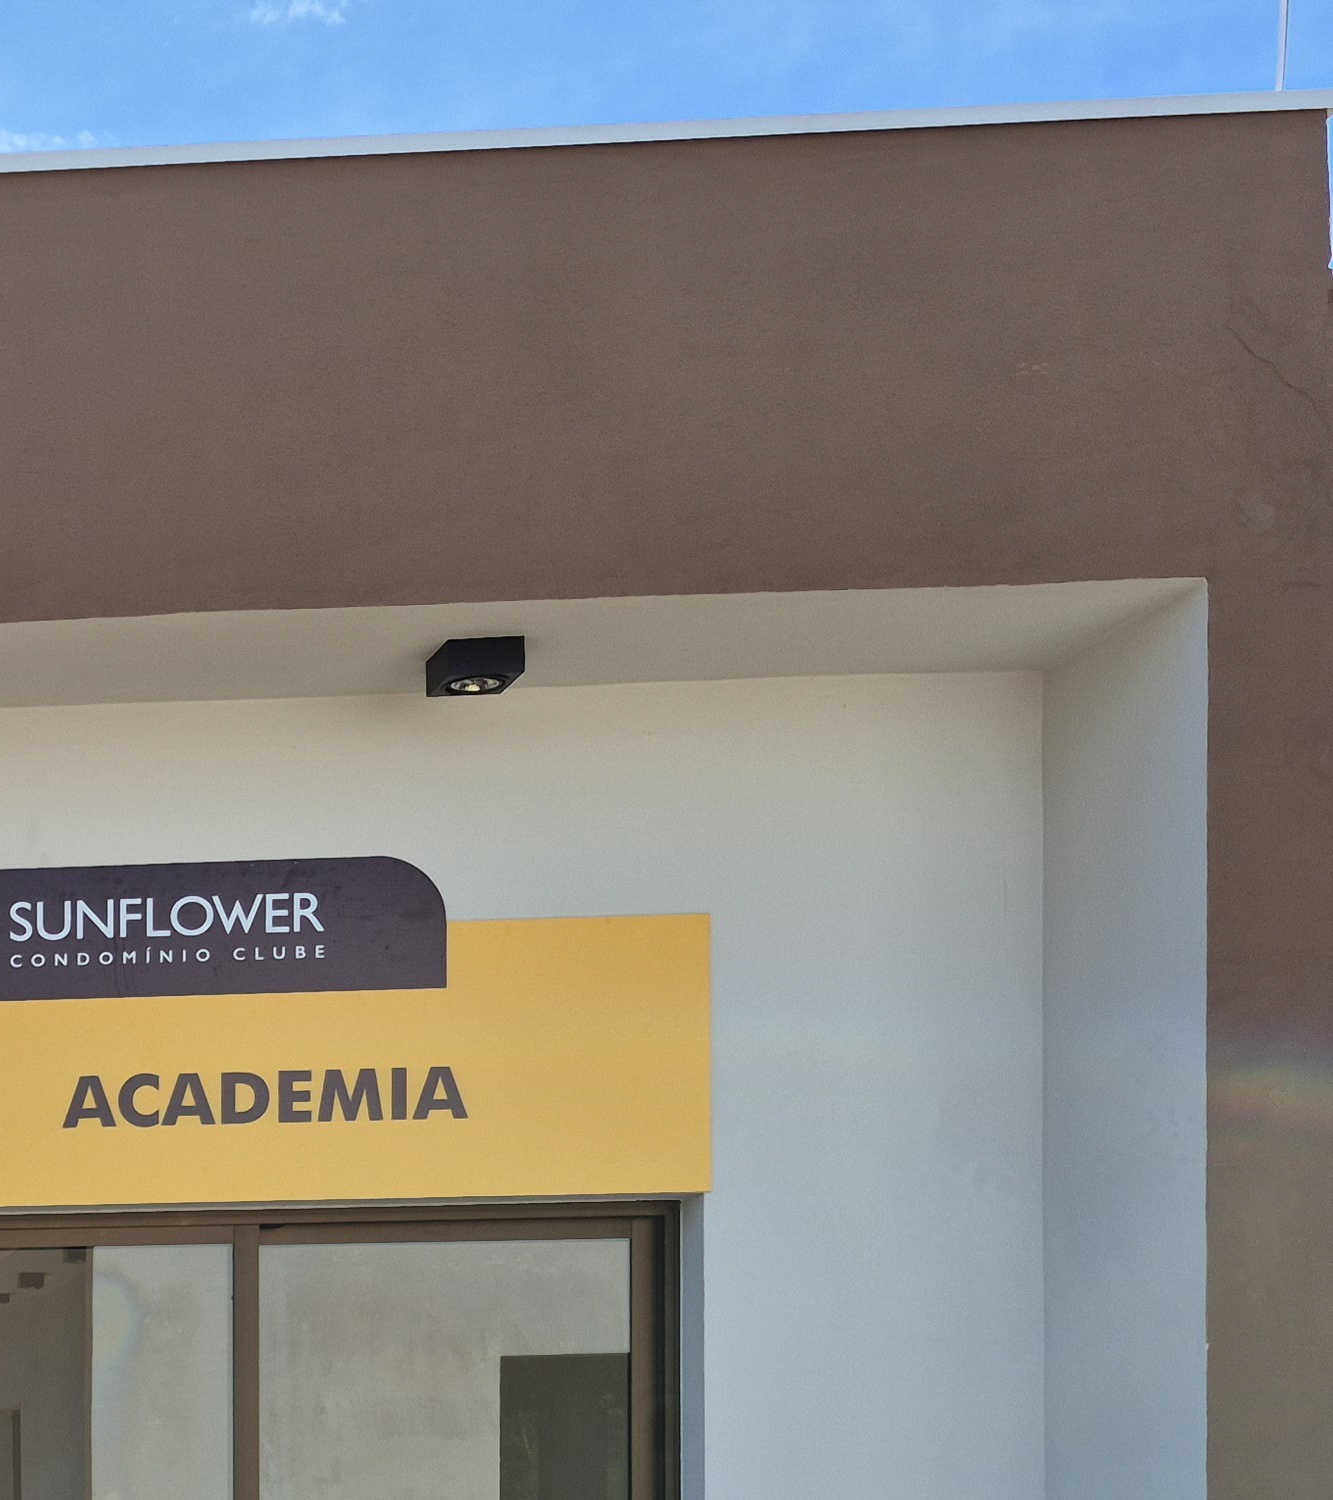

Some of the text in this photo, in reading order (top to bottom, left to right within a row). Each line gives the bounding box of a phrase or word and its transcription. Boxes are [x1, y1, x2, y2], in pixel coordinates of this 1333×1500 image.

[9, 892, 325, 942] SUNFLOWER
[9, 944, 326, 968] CONDOMÍNIO CLUBE
[62, 1066, 469, 1129] ACADEMIA
